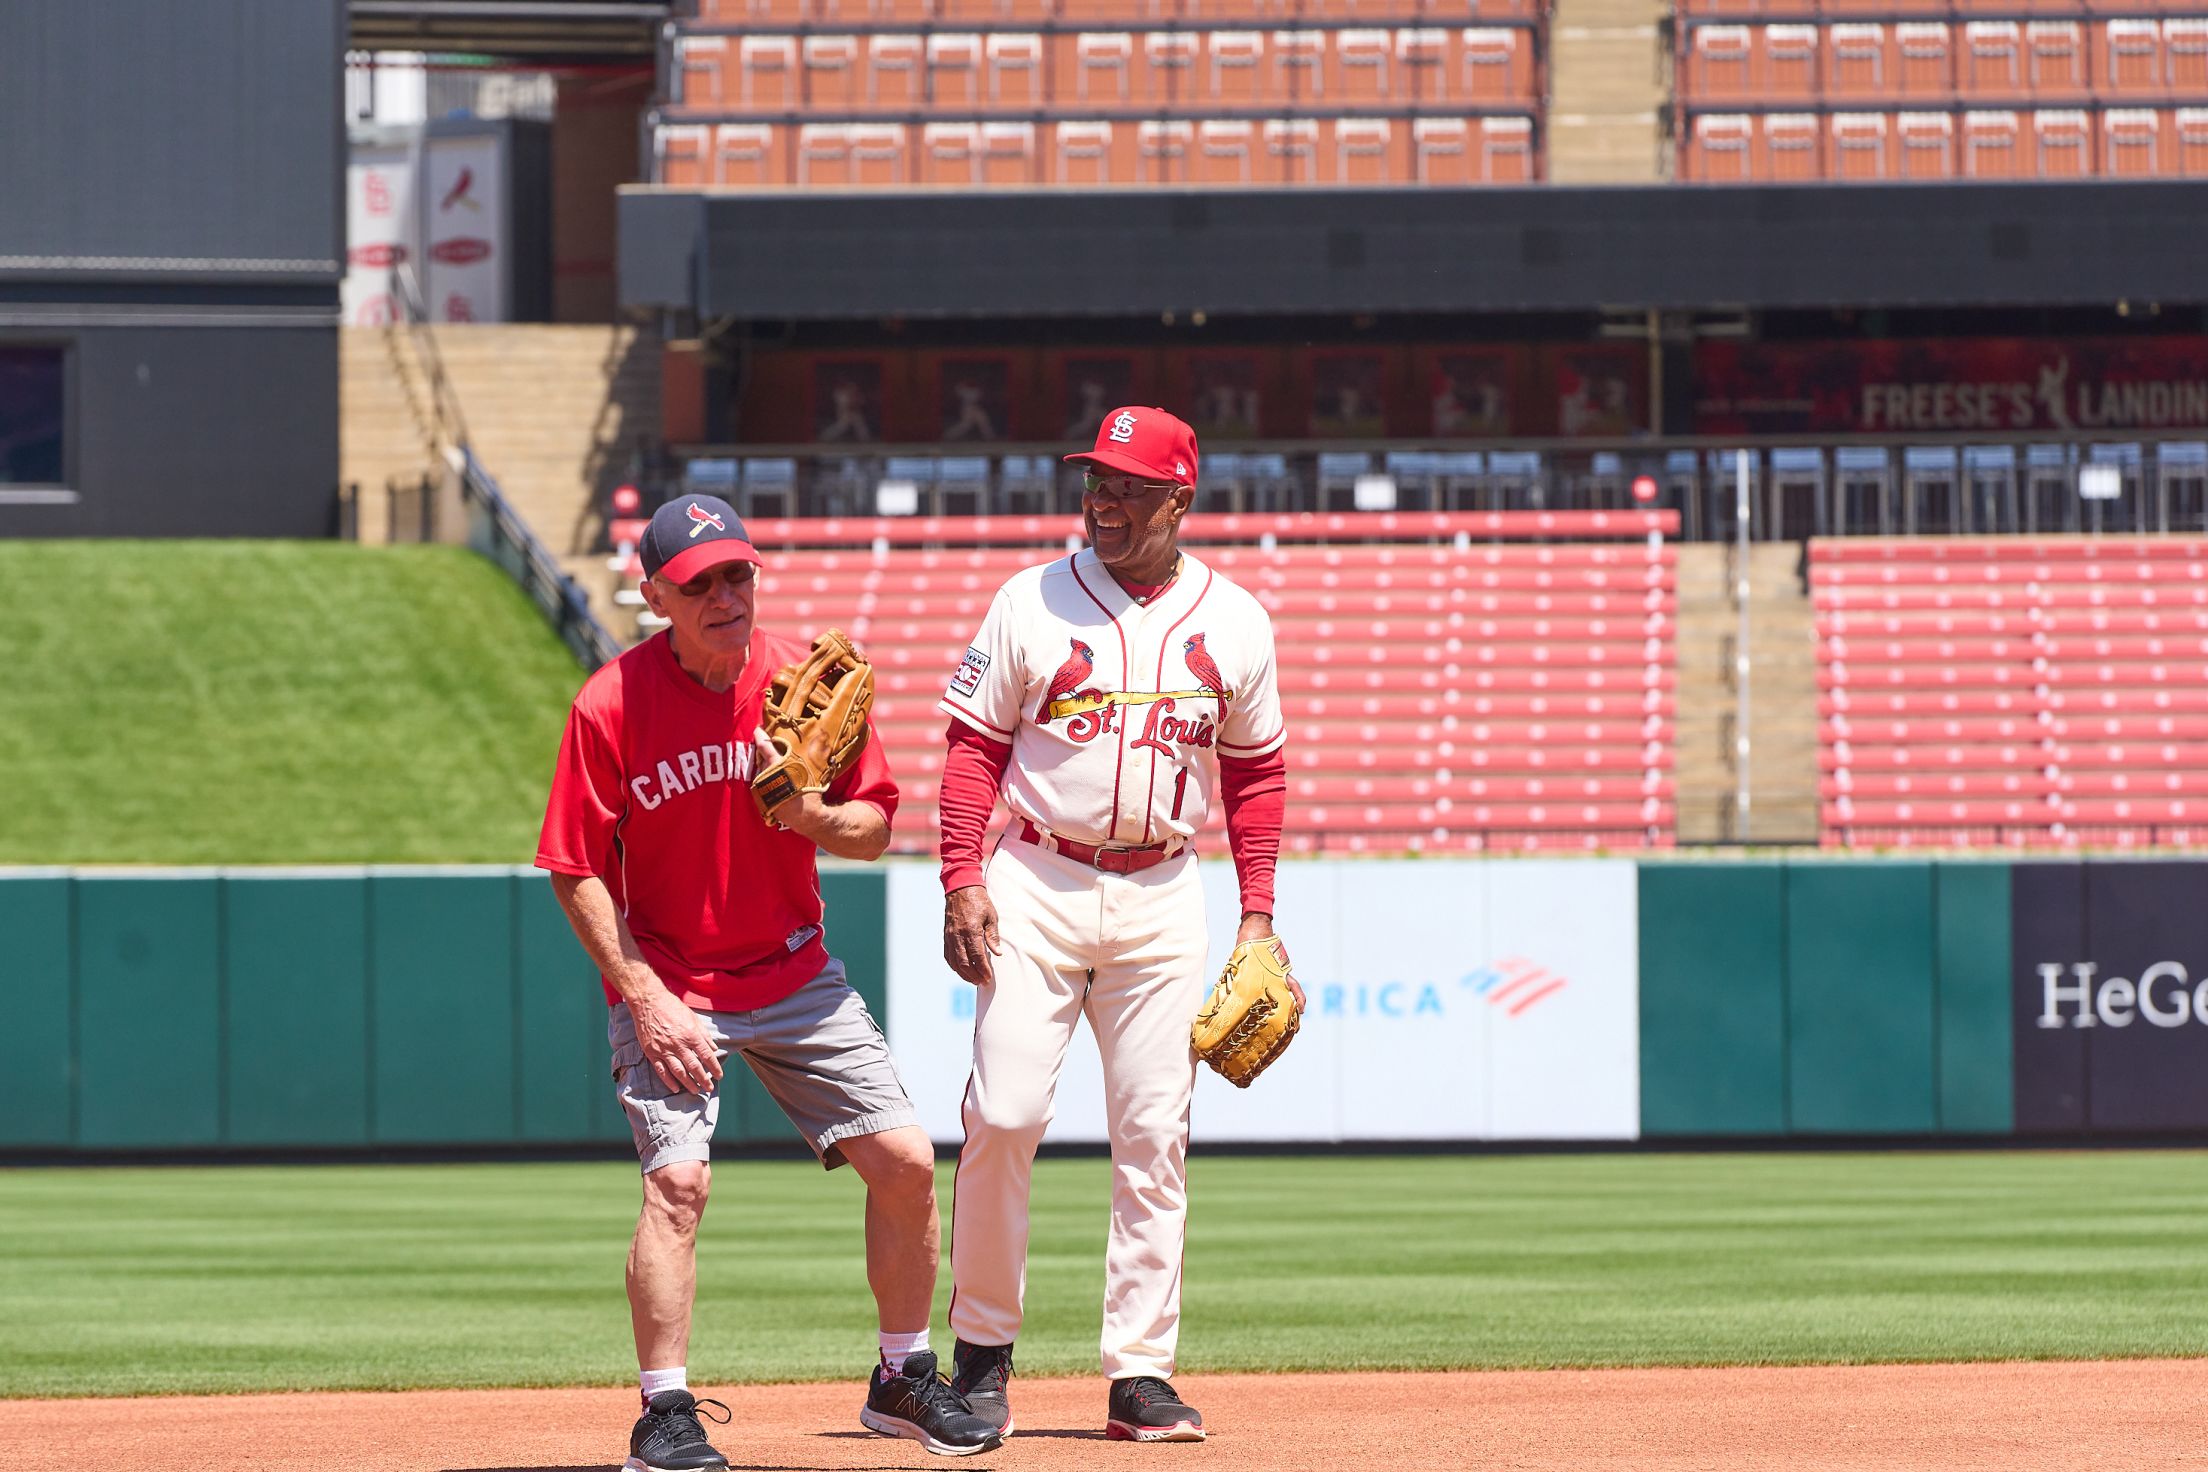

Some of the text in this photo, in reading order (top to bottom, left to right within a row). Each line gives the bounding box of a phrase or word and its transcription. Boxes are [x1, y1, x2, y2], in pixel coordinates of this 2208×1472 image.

[1861, 382, 2033, 428] FREESE'S
[1067, 688, 1214, 759] St. Louis
[630, 740, 756, 810] CARDIN
[1171, 766, 1187, 820] 1
